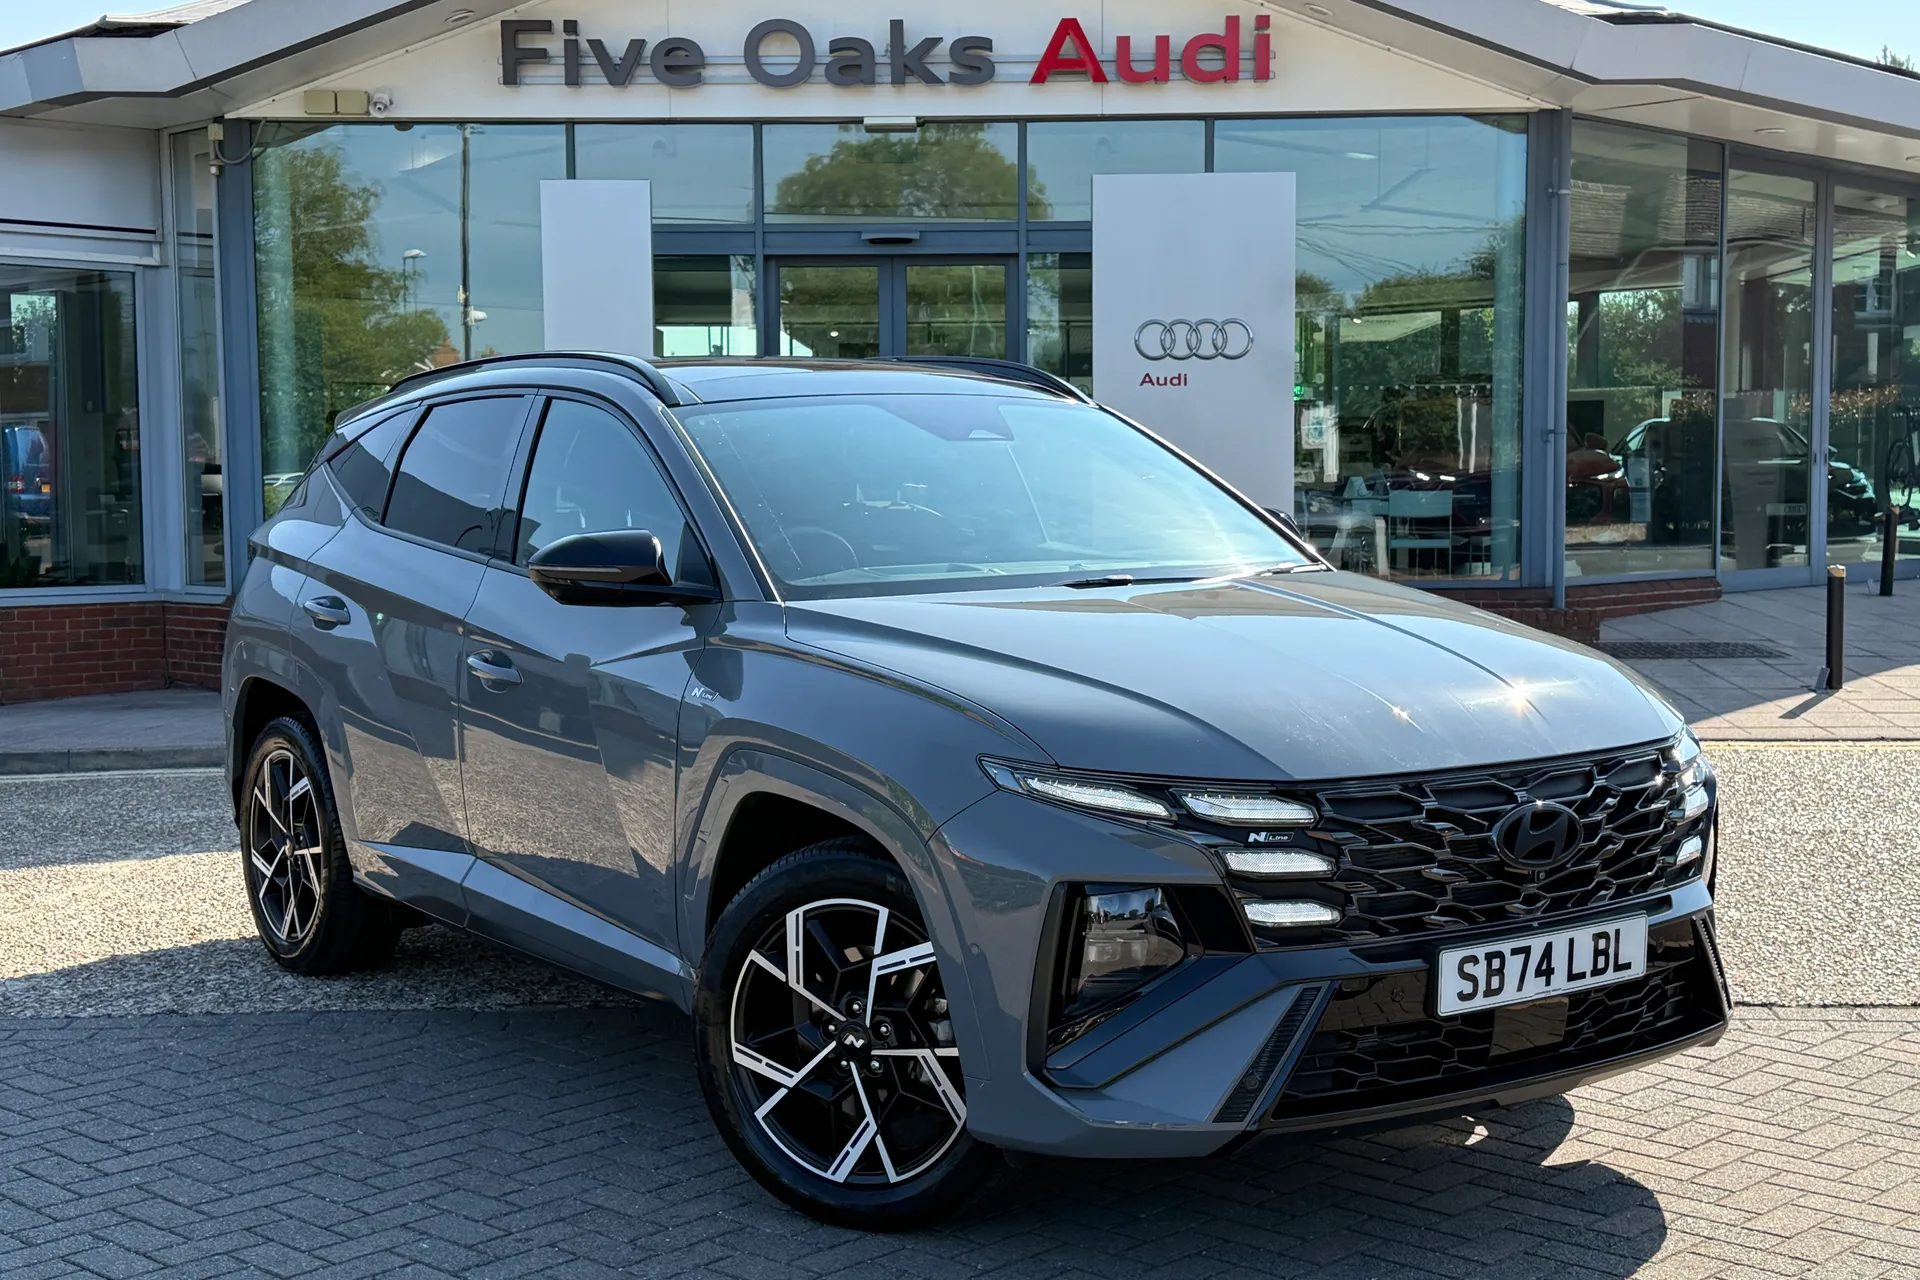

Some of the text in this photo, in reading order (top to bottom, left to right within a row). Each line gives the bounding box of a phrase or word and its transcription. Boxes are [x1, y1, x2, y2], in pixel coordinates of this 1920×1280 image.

[501, 15, 1271, 88] Five Oaks Audi
[1139, 372, 1188, 387] Audi
[1248, 832, 1267, 843] N
[1456, 928, 1632, 1002] SB74 LBL
